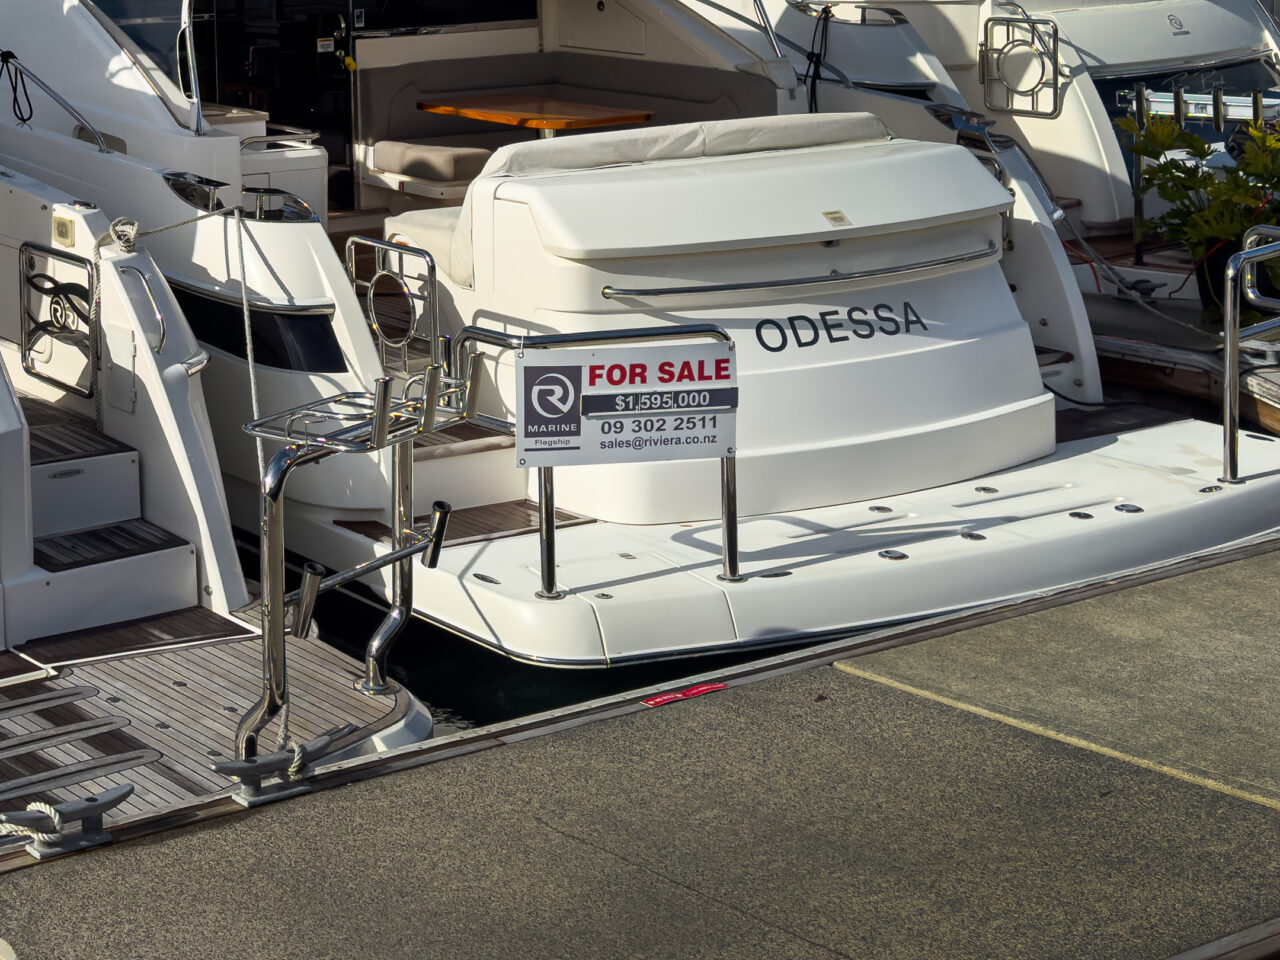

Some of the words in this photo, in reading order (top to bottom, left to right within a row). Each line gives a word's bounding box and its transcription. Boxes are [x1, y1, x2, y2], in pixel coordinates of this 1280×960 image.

[755, 301, 929, 353] ODESSA
[588, 363, 648, 387] FOR
[658, 358, 731, 383] SALE
[615, 391, 710, 412] $1,595,000
[528, 423, 577, 433] MARINE
[600, 420, 624, 435] 09
[631, 418, 667, 433] 302
[673, 415, 718, 431] 2511
[534, 439, 571, 448] Flagship
[600, 434, 717, 450] sales@riviera.co.nz
